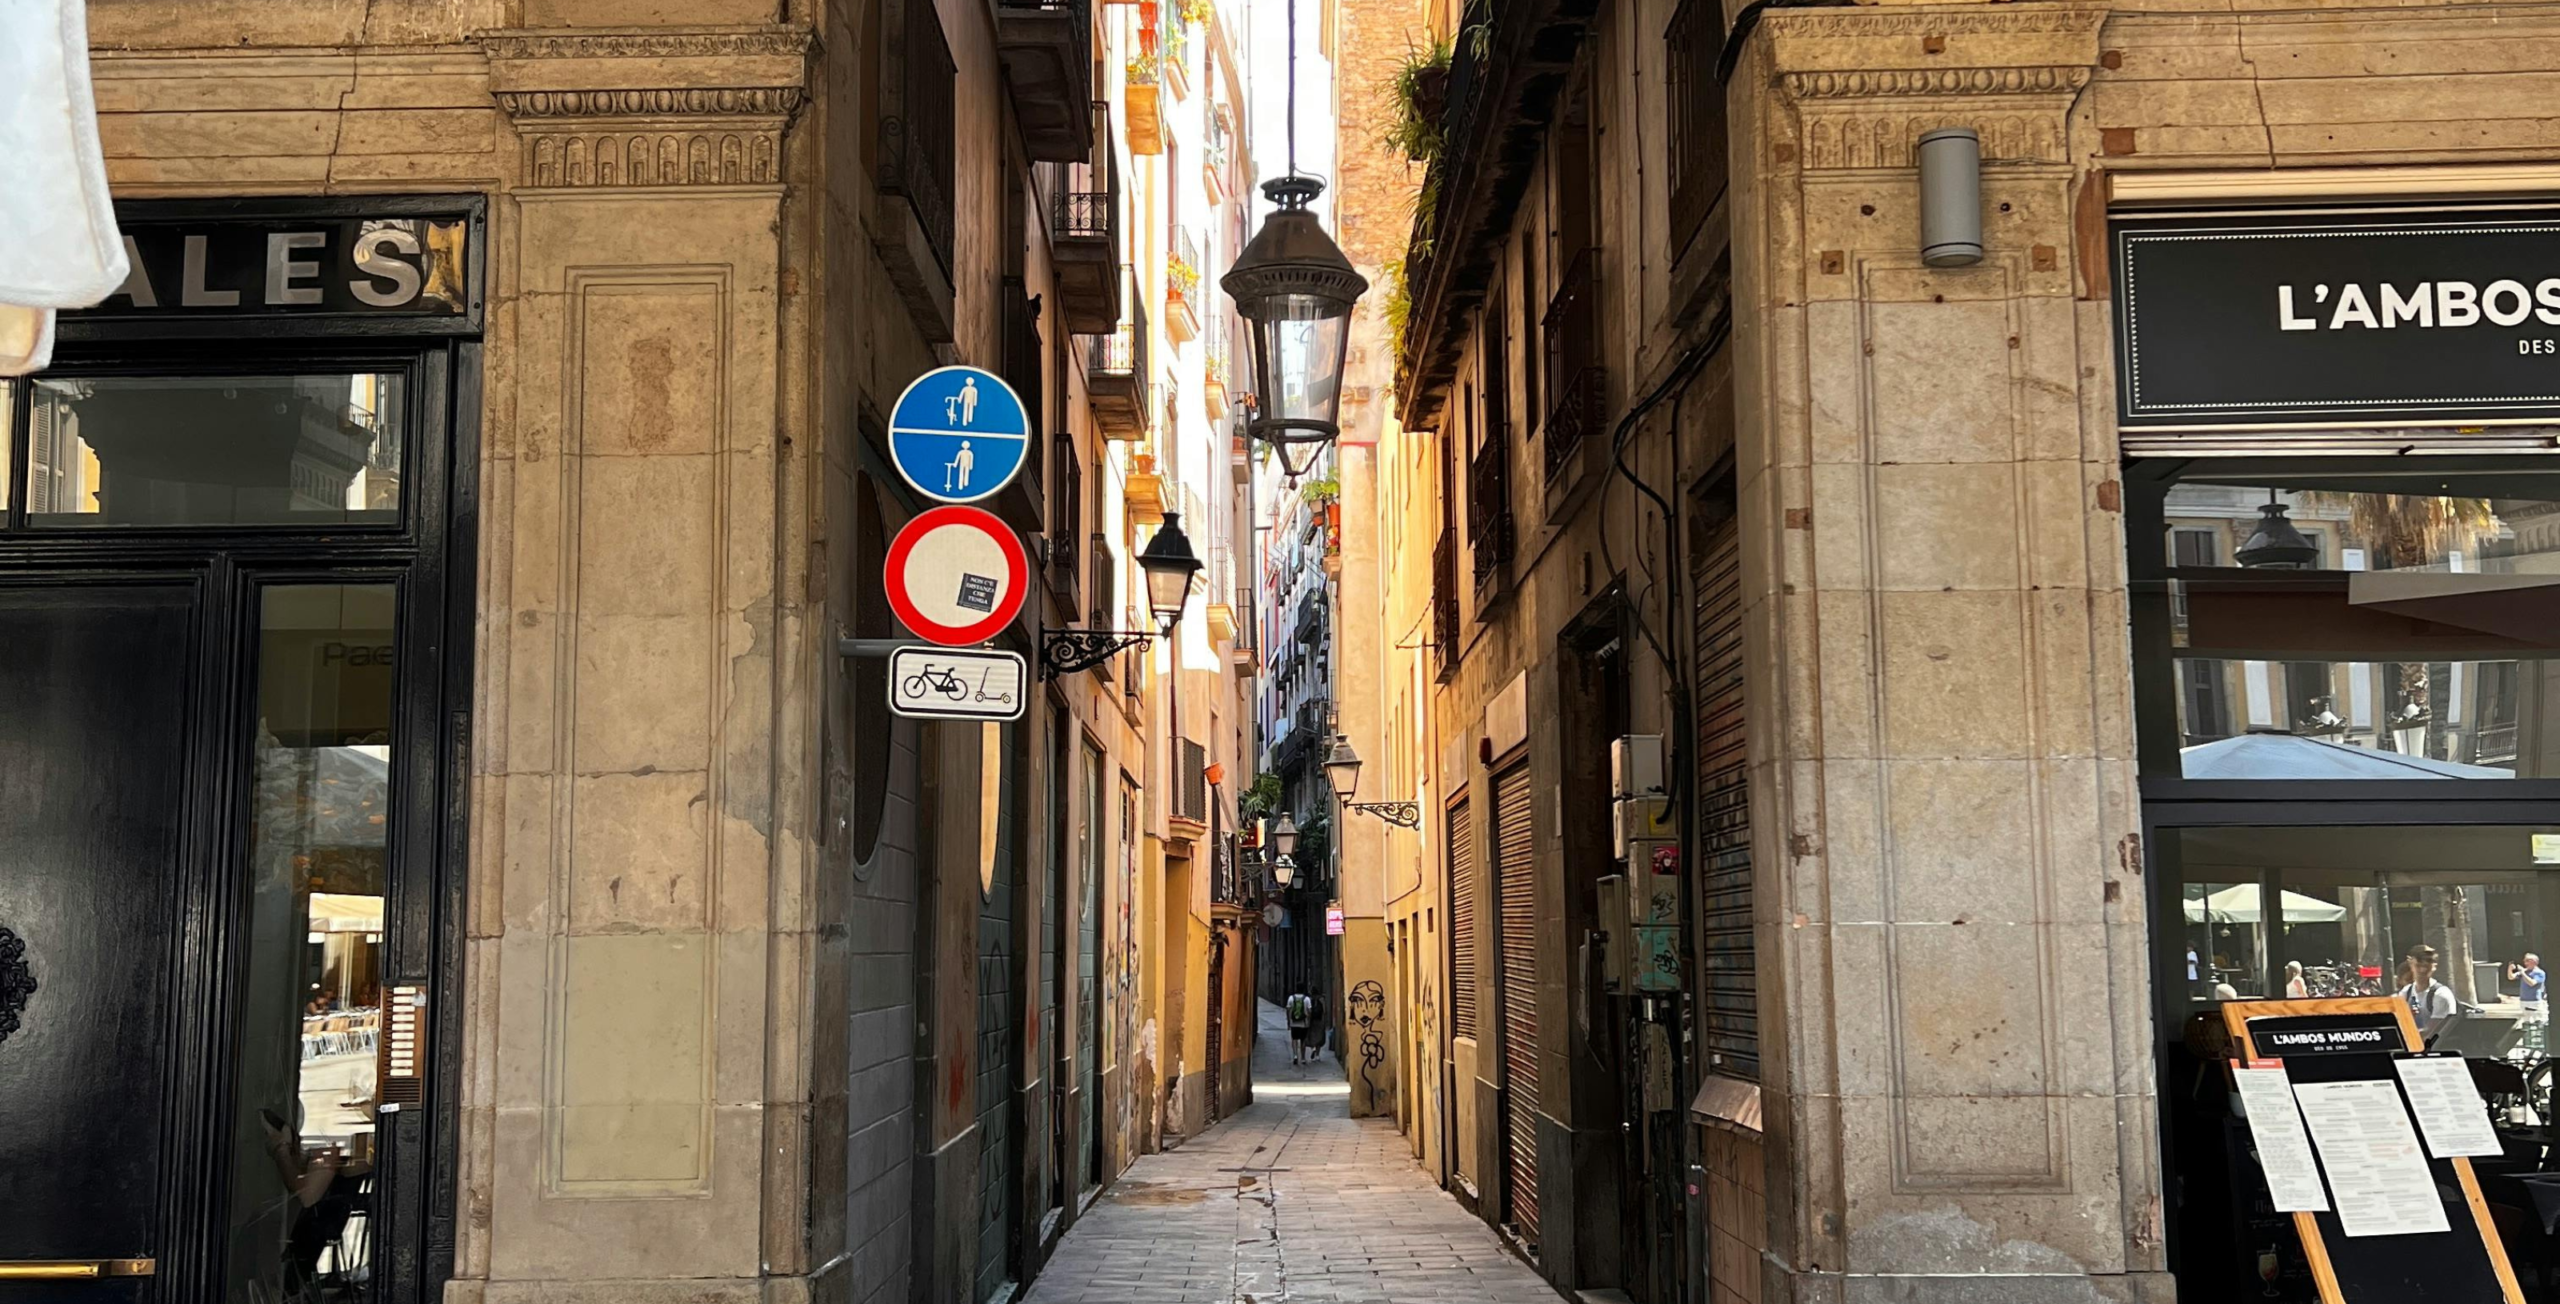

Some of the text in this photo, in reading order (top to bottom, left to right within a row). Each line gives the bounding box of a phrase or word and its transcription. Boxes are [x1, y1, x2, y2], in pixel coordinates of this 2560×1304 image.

[2519, 339, 2556, 355] DES
[970, 577, 984, 585] NON
[966, 582, 995, 593] DISTANZA
[972, 590, 987, 598] CHE
[968, 595, 988, 605] TENGA
[2273, 1031, 2381, 1045] L'AMBOS MUNDOS
